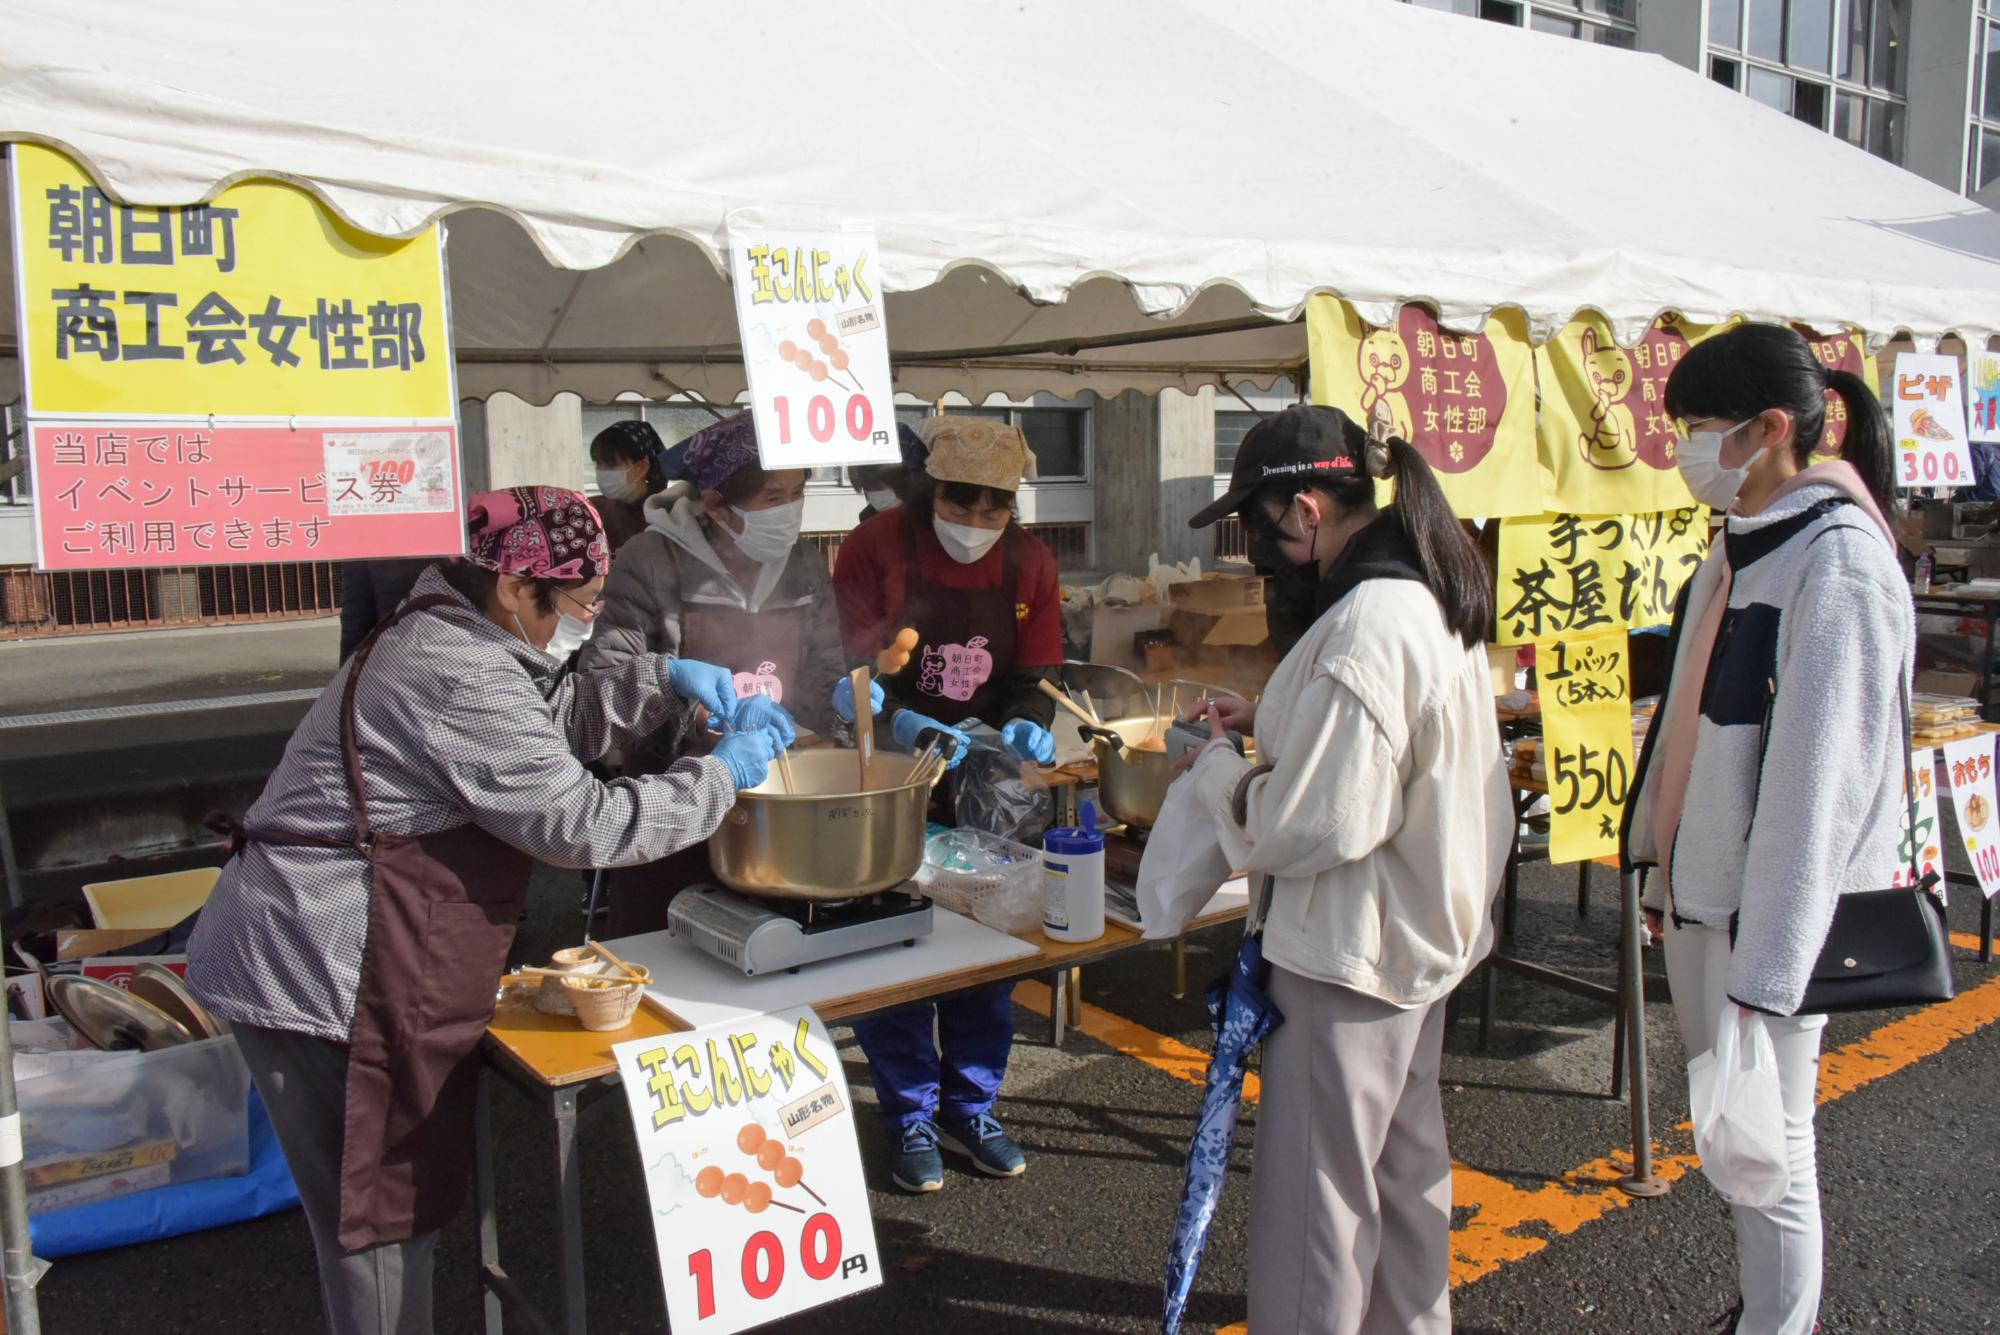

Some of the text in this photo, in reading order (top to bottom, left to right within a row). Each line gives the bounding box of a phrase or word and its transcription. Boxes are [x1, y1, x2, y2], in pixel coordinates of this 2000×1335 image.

[46, 184, 239, 273] 朝日町
[748, 244, 873, 305] 玉こんにゃく
[51, 283, 426, 371] 商工会女性部
[841, 312, 874, 329] 山形名物
[1416, 328, 1478, 362] 朝日町
[1420, 365, 1482, 398] 商工会
[1898, 373, 1953, 401] ピザ
[773, 394, 889, 445] 100円
[1422, 403, 1487, 434] 女性部
[53, 432, 212, 466] 当店では
[1262, 463, 1297, 476] Dressing
[1298, 461, 1306, 471] is
[1313, 460, 1330, 470] way
[1331, 456, 1340, 468] of
[58, 473, 402, 510] イベントサービス券
[63, 516, 331, 555] ご利用できます
[952, 654, 984, 664] 朝日町
[1554, 743, 1628, 814] 550
[1952, 754, 1991, 788] おもち
[637, 1018, 828, 1132] 玉こんにゃく
[787, 1094, 835, 1127] 山形名物
[688, 1213, 867, 1320] 100円
